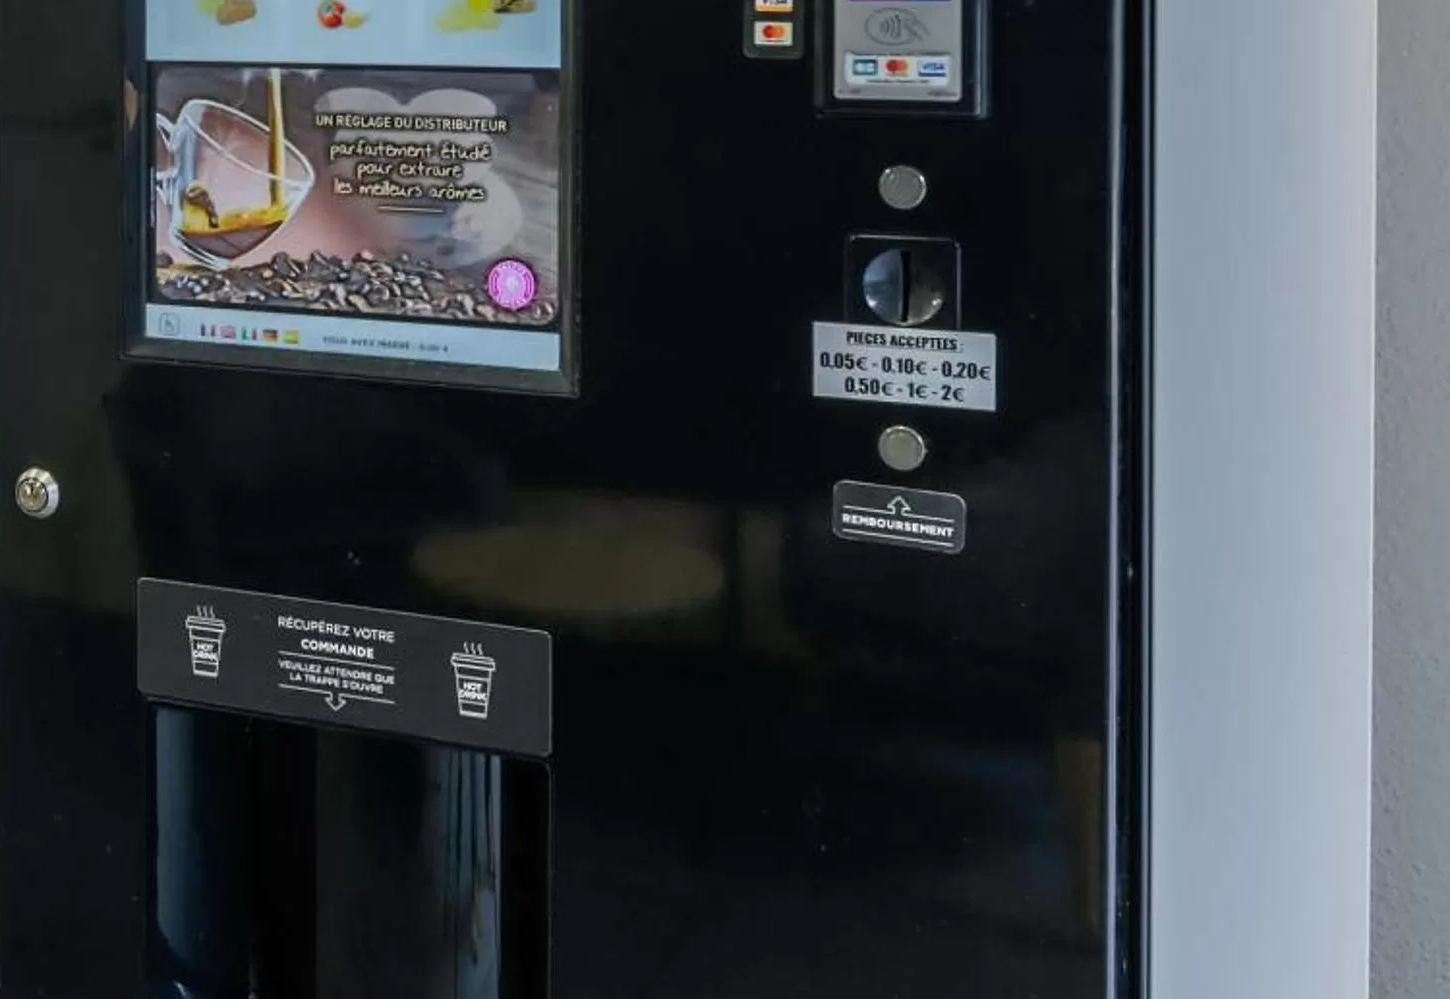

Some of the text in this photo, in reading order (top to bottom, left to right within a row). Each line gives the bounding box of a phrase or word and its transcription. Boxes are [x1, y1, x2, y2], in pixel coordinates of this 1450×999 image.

[316, 114, 333, 127] UN
[394, 116, 412, 129] DU
[415, 117, 507, 132] DISTRIBUTEUR
[330, 139, 431, 160] parfaitement
[357, 160, 463, 180] pour extraire
[334, 179, 485, 200] les meilleurs arômes
[907, 383, 930, 399] 1€
[941, 384, 965, 402] 2€
[841, 513, 954, 537] REMBOURSEMENT
[278, 615, 395, 643] RÉCUPÉREZ VOTRE
[196, 642, 214, 652] HOT
[301, 638, 374, 660] COMMANDE
[278, 658, 395, 685] VEUILLEZ ATTENDRE QUE
[290, 671, 302, 681] LA
[304, 673, 340, 689] TRAPPE
[463, 682, 482, 693] HOT
